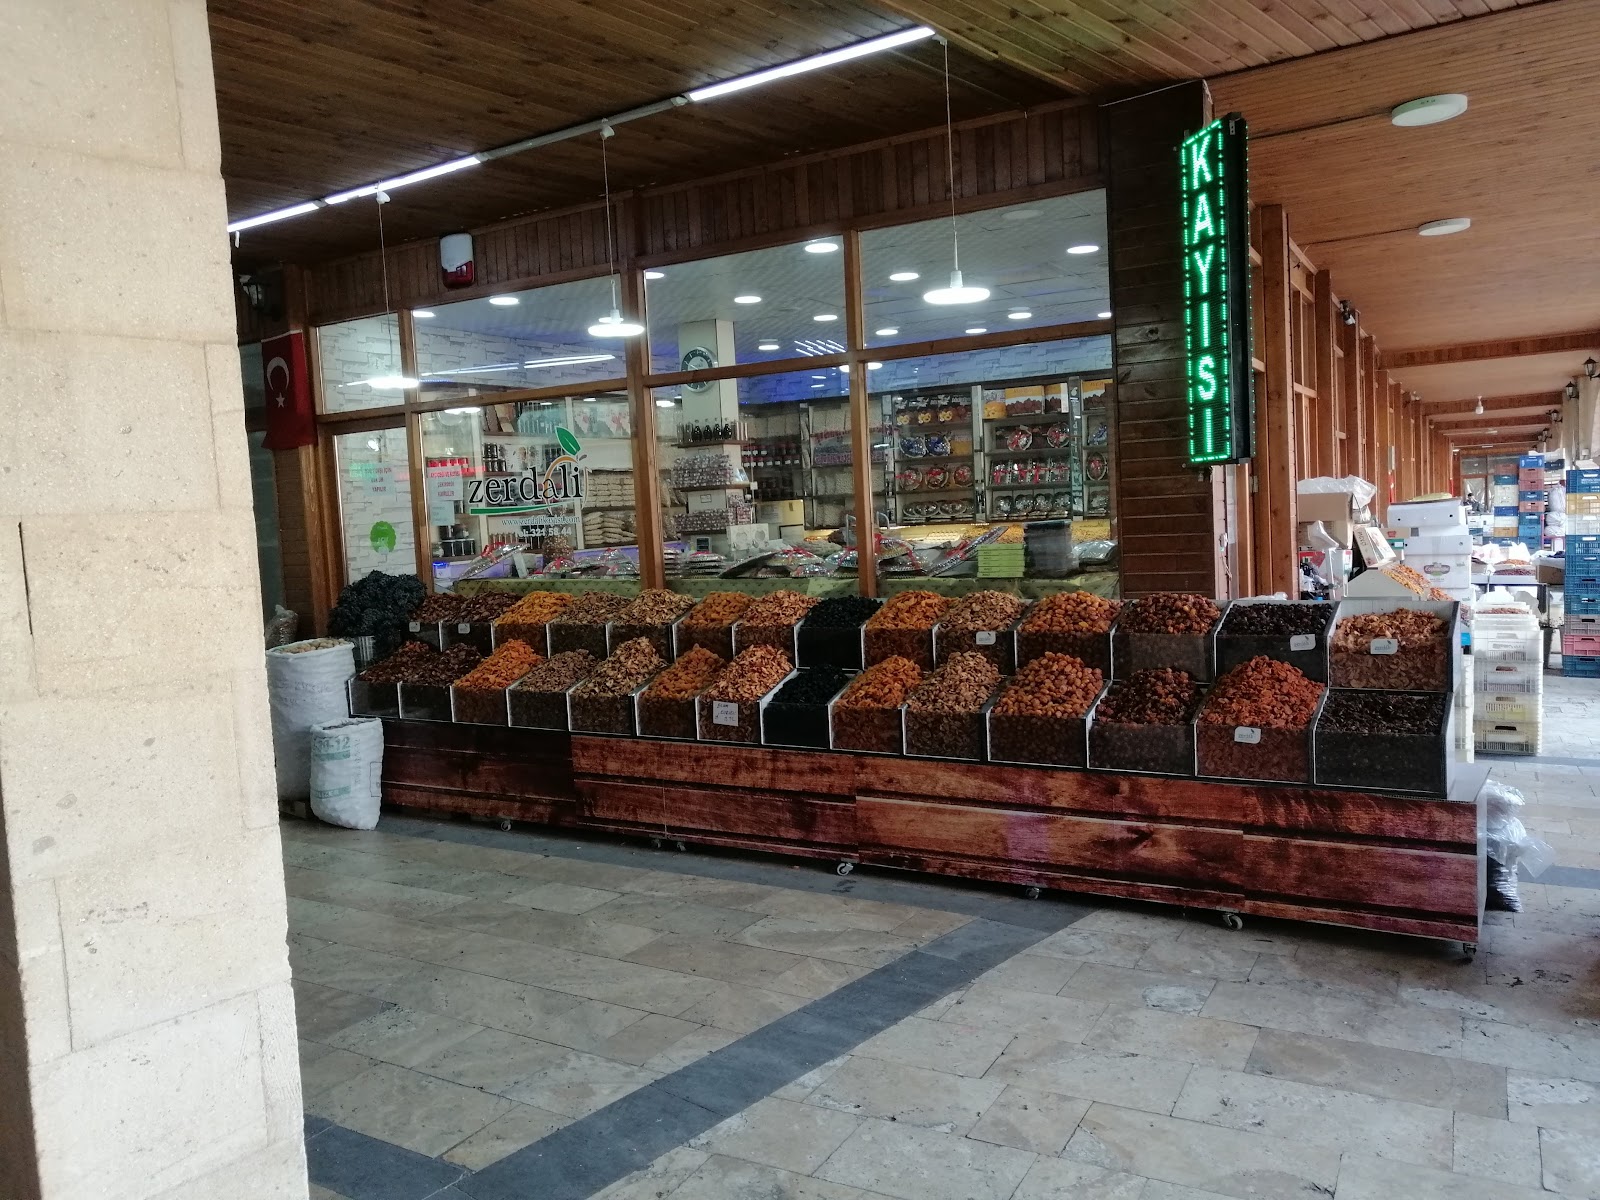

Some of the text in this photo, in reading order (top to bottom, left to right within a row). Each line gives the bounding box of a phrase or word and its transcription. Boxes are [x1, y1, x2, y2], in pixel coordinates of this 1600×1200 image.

[1190, 134, 1217, 453] KAYISI
[468, 463, 584, 504] zerdali
[530, 528, 545, 536] 321
[548, 527, 558, 536] 58
[561, 527, 572, 535] 44
